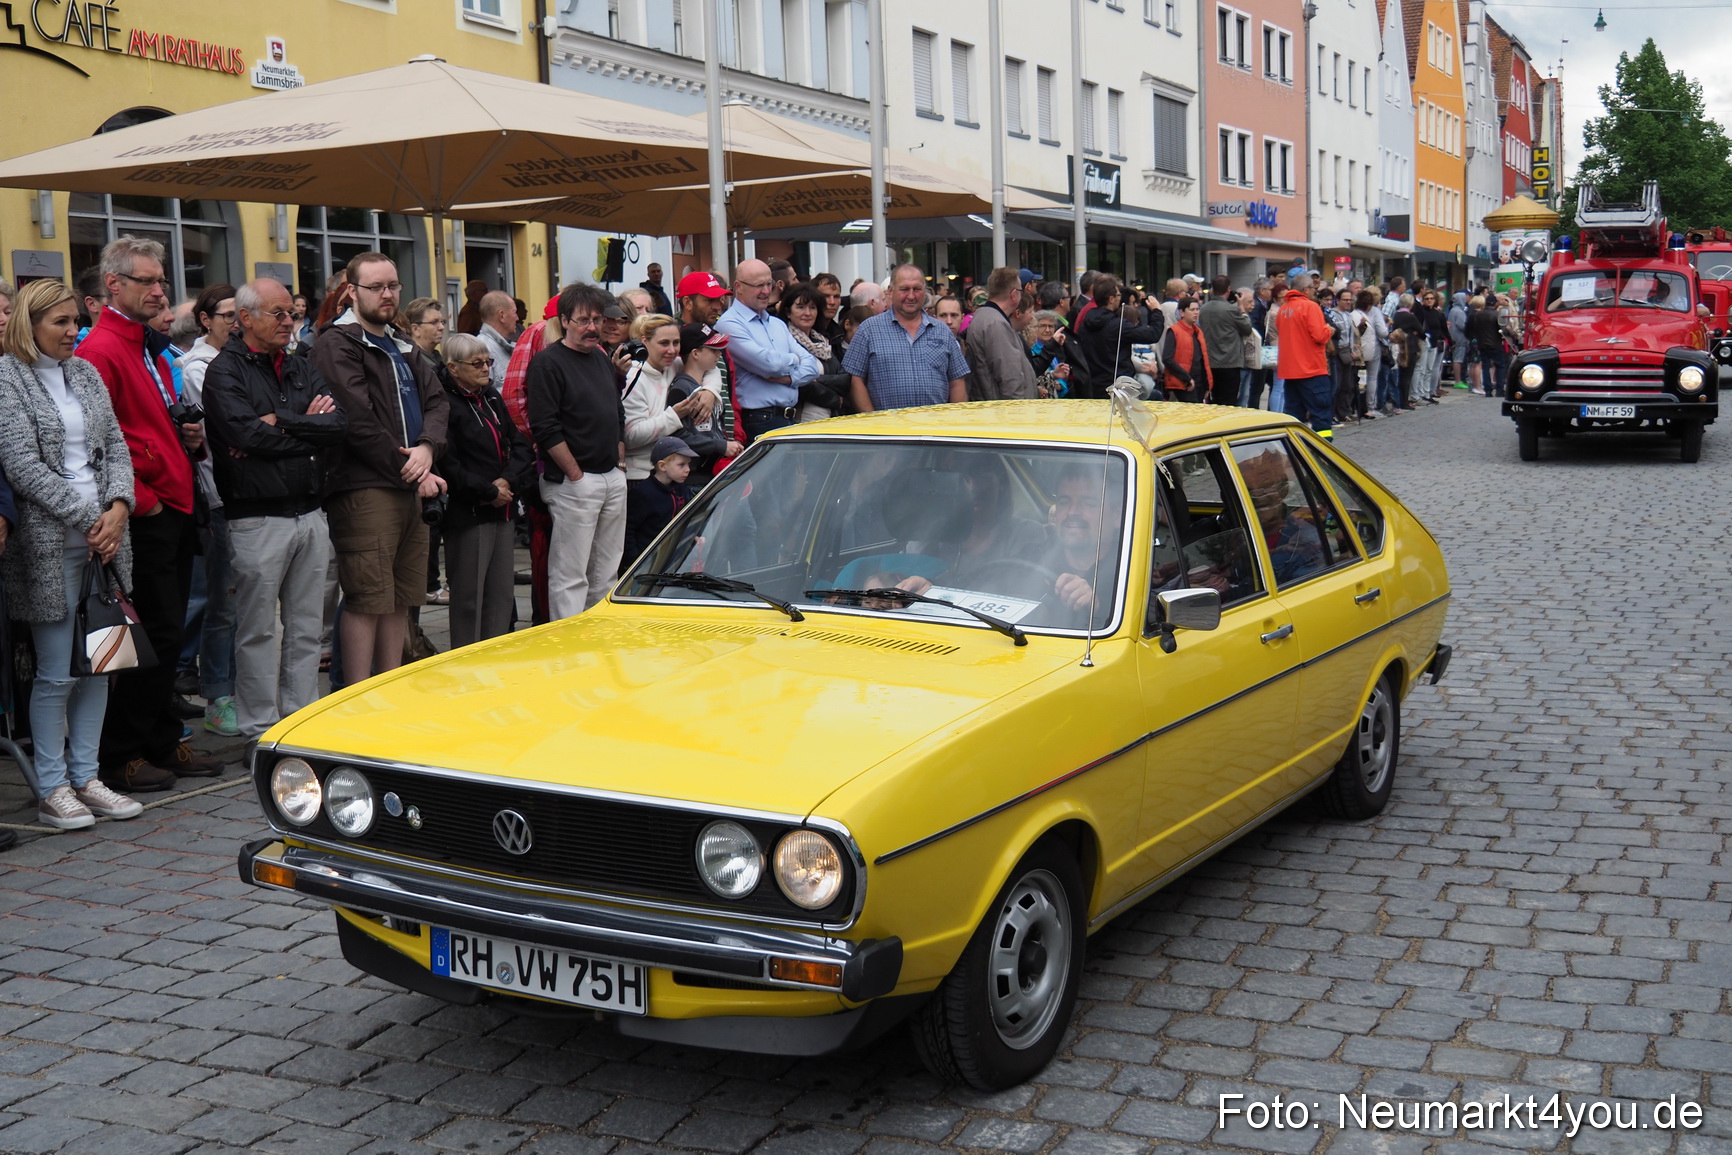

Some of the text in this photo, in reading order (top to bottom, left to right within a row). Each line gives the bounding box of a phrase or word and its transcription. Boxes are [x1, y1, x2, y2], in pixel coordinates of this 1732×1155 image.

[31, 0, 122, 52] CAFÉ
[128, 28, 245, 75] AM RATHAUS
[262, 64, 296, 78] Neumarkter
[256, 72, 303, 89] Lammsbräu
[531, 243, 542, 257] 24
[1586, 406, 1600, 416] NM
[1605, 406, 1619, 416] FF
[1620, 406, 1634, 417] 59
[969, 601, 1010, 614] 485
[437, 955, 445, 967] D
[450, 933, 642, 1007] RH VW 75H
